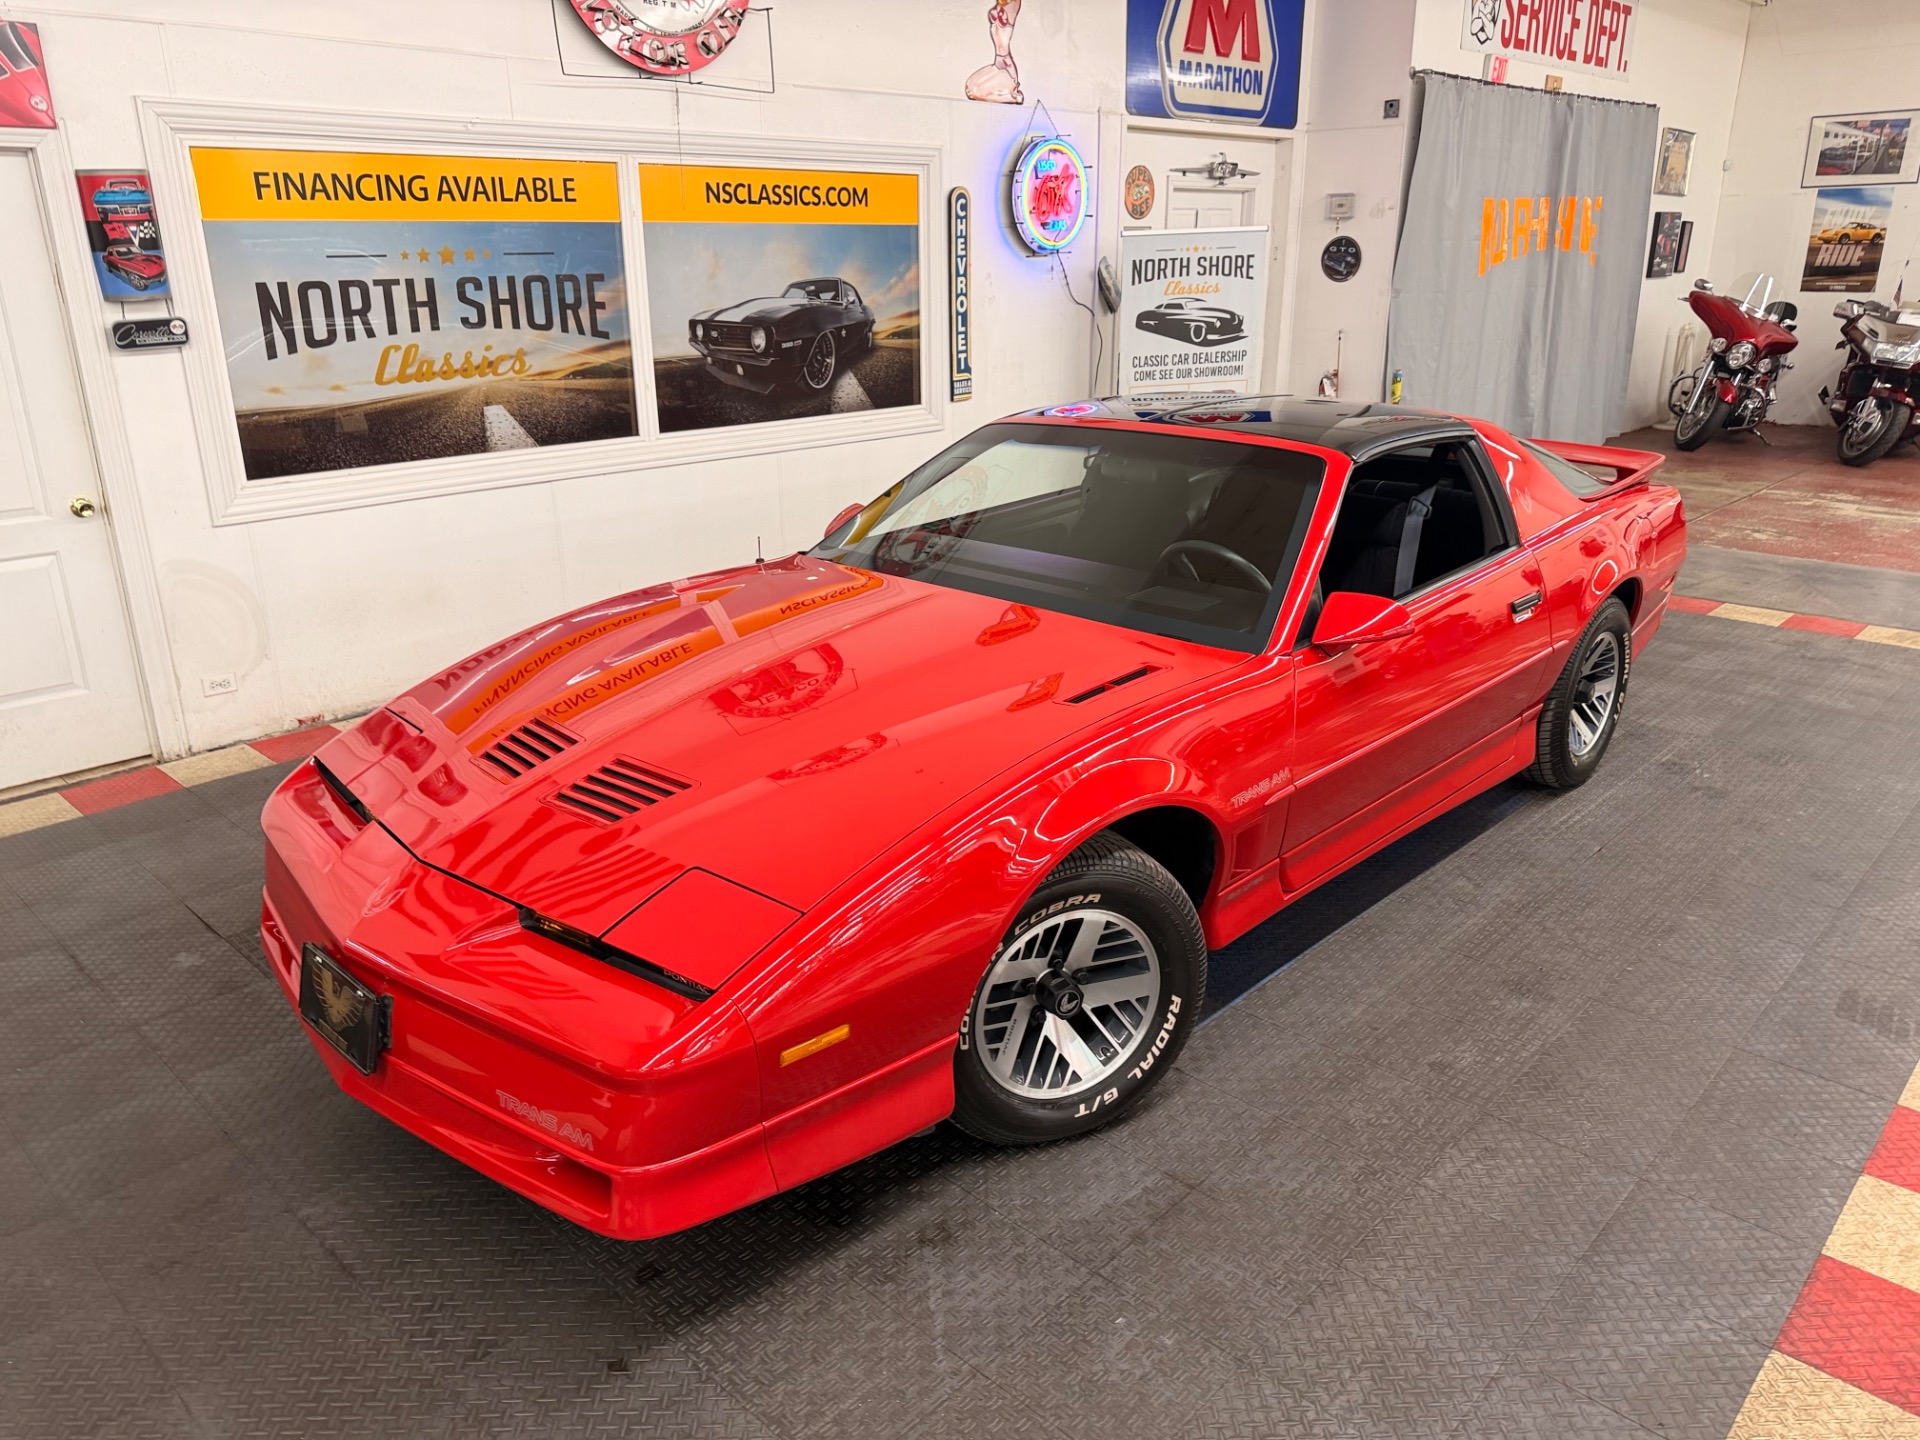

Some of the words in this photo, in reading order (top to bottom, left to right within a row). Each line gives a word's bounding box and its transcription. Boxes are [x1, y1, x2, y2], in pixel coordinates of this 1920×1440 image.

[1183, 0, 1260, 63] M
[1501, 0, 1581, 62] SERVICE
[1583, 0, 1633, 73] DEPT.
[1177, 59, 1264, 96] MARATHON
[253, 171, 429, 202] FINANCING
[436, 175, 578, 203] AVAILABLE
[704, 180, 869, 208] NSCLASSICS.COM
[1329, 245, 1356, 254] GTO
[1814, 243, 1866, 267] RIDE
[955, 197, 968, 371] CHEVROLET
[1131, 257, 1191, 286] NORTH
[1196, 253, 1255, 281] SHORE
[1163, 280, 1222, 296] Classics
[255, 277, 440, 361] NORTH
[456, 272, 611, 341] SHORE
[374, 342, 534, 386] Classics
[1132, 354, 1169, 369] CLASSIC
[1171, 353, 1190, 366] CAR
[1192, 349, 1248, 365] DEALERSHIP
[1133, 368, 1157, 382] COME
[1158, 368, 1174, 381] SEE
[1175, 367, 1193, 380] OUR
[1194, 364, 1244, 379] SHOWROOM!
[1231, 777, 1271, 809] TRANS
[1270, 766, 1291, 788] AM
[1014, 893, 1101, 936] COBRA
[1127, 994, 1182, 1079] RADIAL
[496, 1089, 558, 1132] TRANS
[558, 1122, 594, 1152] AM
[1074, 1087, 1119, 1118] G/T
